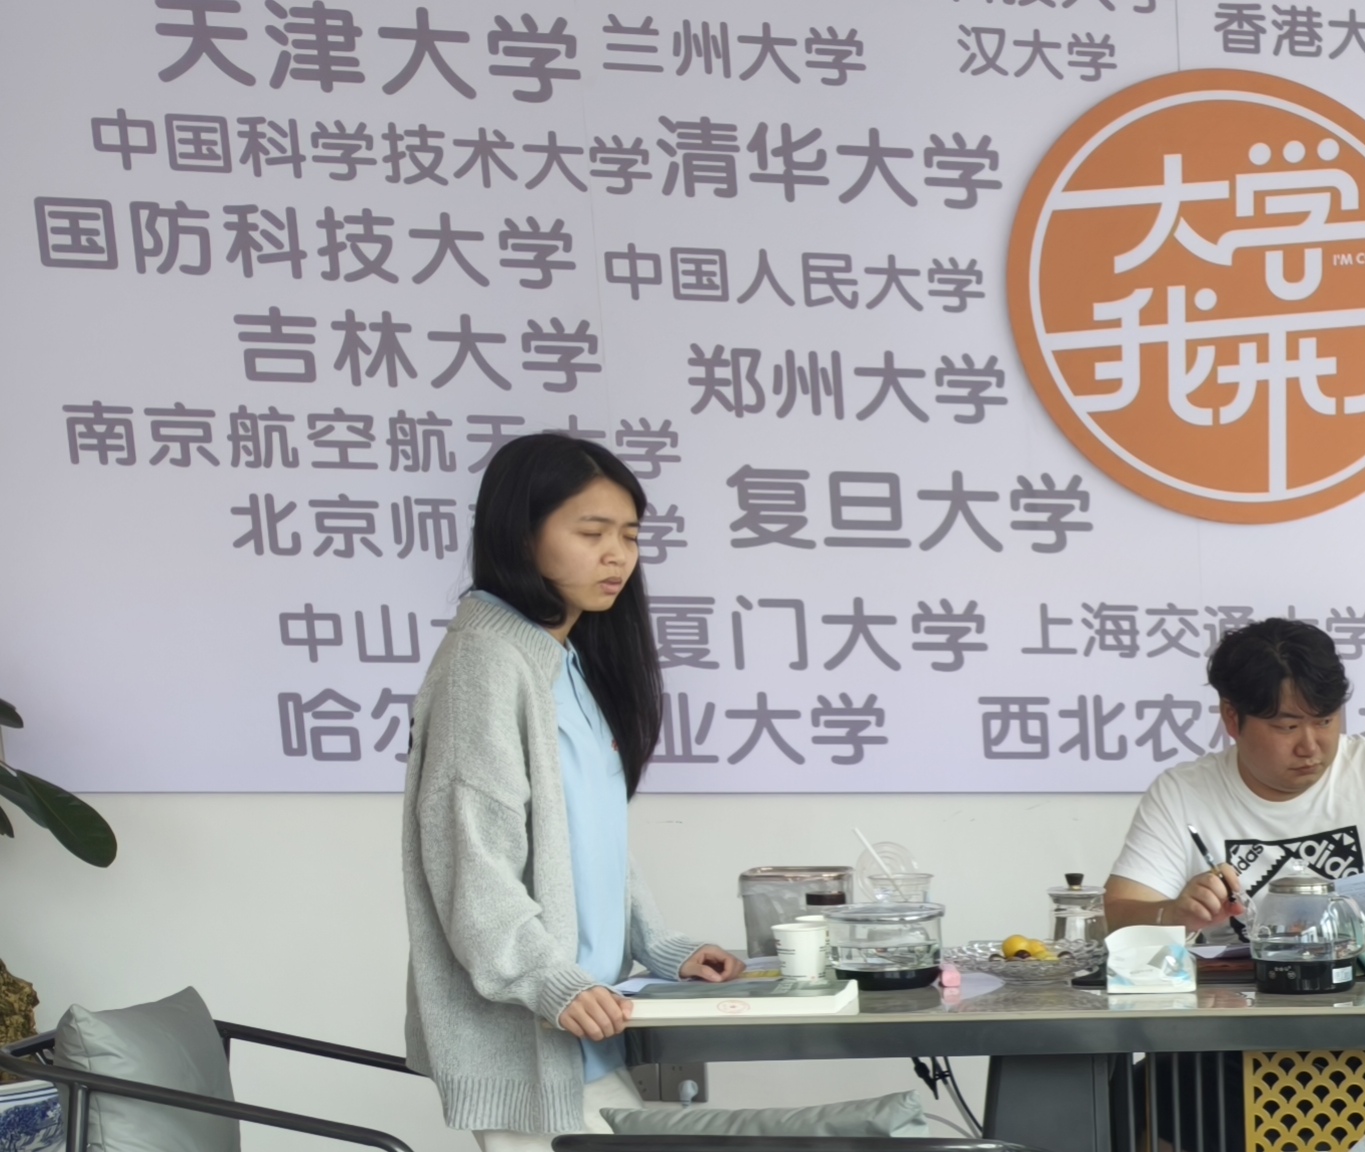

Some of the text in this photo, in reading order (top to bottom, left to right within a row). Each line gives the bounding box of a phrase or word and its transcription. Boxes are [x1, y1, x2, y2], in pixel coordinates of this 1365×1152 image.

[155, 0, 581, 103] 天津大学
[602, 14, 866, 86] 兰州大学
[957, 24, 1118, 82] 汉大学
[91, 108, 653, 195] 中国科学技术大学
[656, 116, 1003, 209] 清华大学
[34, 196, 577, 290] 国防科技大学
[604, 243, 986, 313] 中国人民大学
[1333, 254, 1353, 266] I'M
[234, 306, 602, 393] 吉林大学
[687, 343, 1008, 424] 郑州大学
[62, 400, 682, 480] 南京航空航天学
[231, 493, 688, 564] 北京师学
[726, 464, 1094, 554] 复旦大学
[648, 596, 988, 672] 厦门大学
